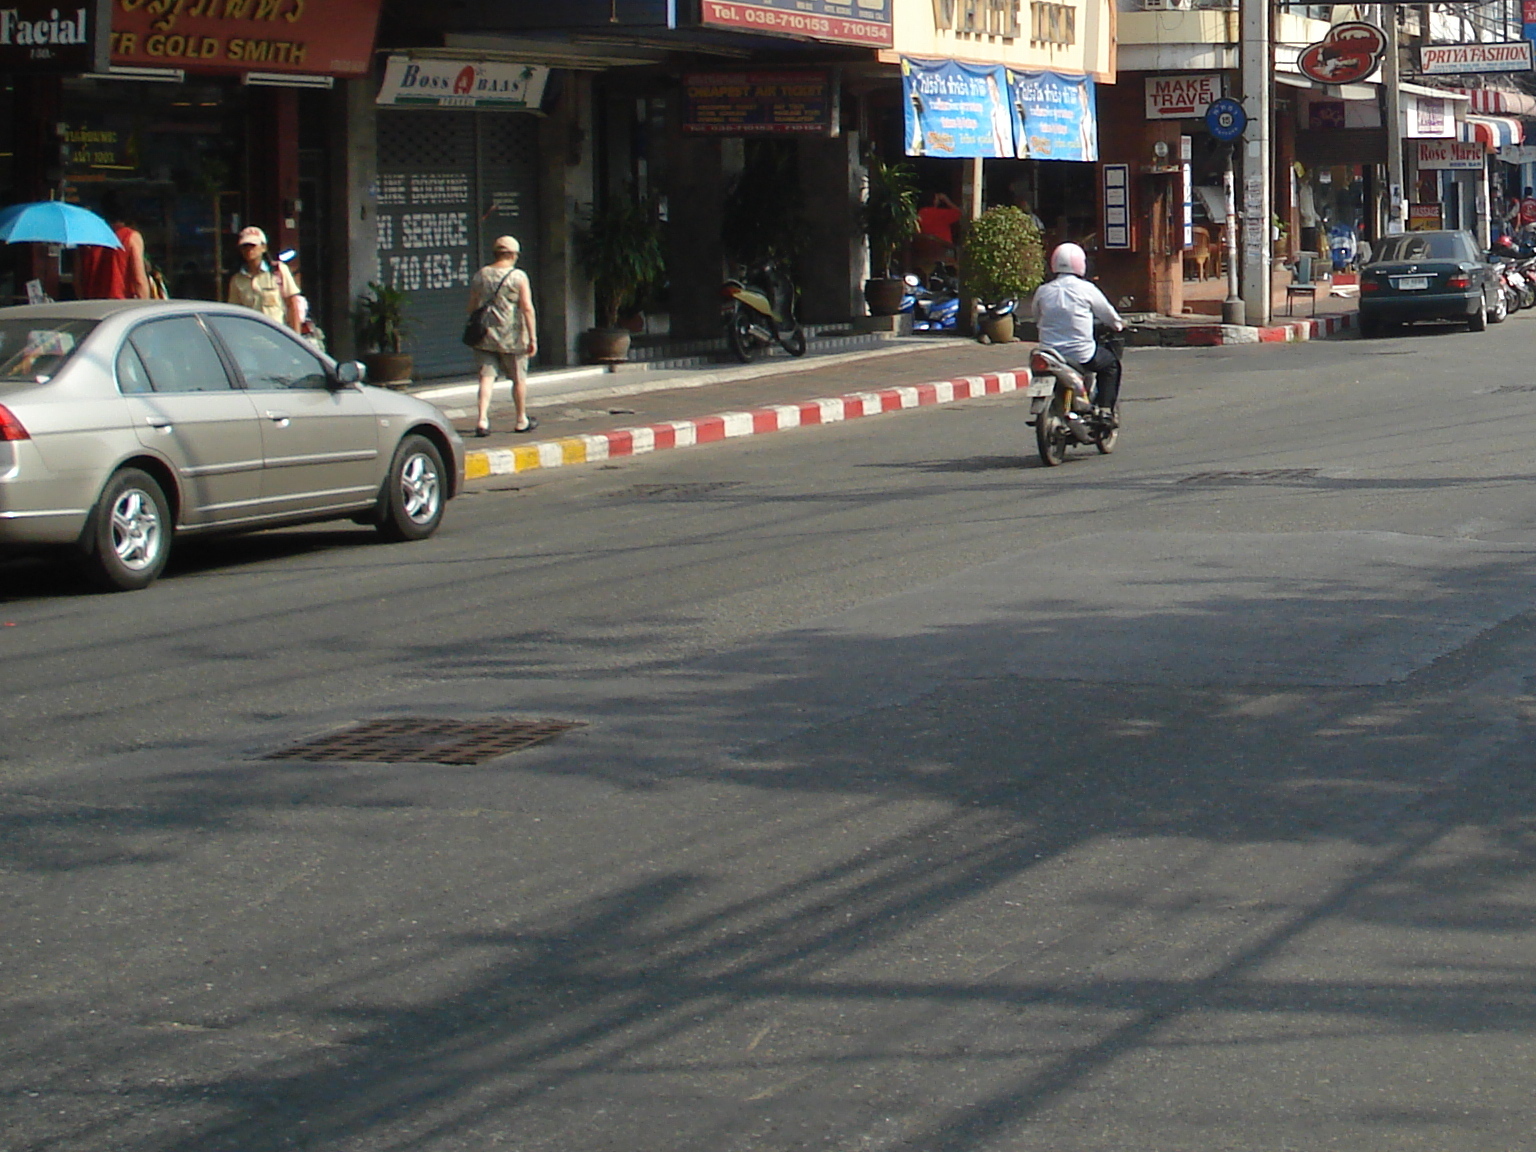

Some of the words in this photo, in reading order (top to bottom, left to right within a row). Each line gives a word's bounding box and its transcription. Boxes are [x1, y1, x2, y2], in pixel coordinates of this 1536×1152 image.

[0, 7, 87, 46] Facial
[711, 3, 740, 21] Tel.
[745, 9, 830, 32] 038-710153
[842, 22, 888, 39] 710154
[1029, 0, 1077, 47] INN
[146, 32, 220, 59] GOLD
[227, 37, 307, 65] SMITH
[1423, 49, 1472, 71] PRIYA
[1470, 45, 1529, 62] FASHION
[1155, 77, 1211, 94] MAKE
[1221, 115, 1231, 125] 15
[1419, 144, 1447, 162] Rose
[1450, 143, 1482, 161] Marie
[1410, 205, 1441, 217] MASSAGE
[402, 212, 468, 249] SERVICE
